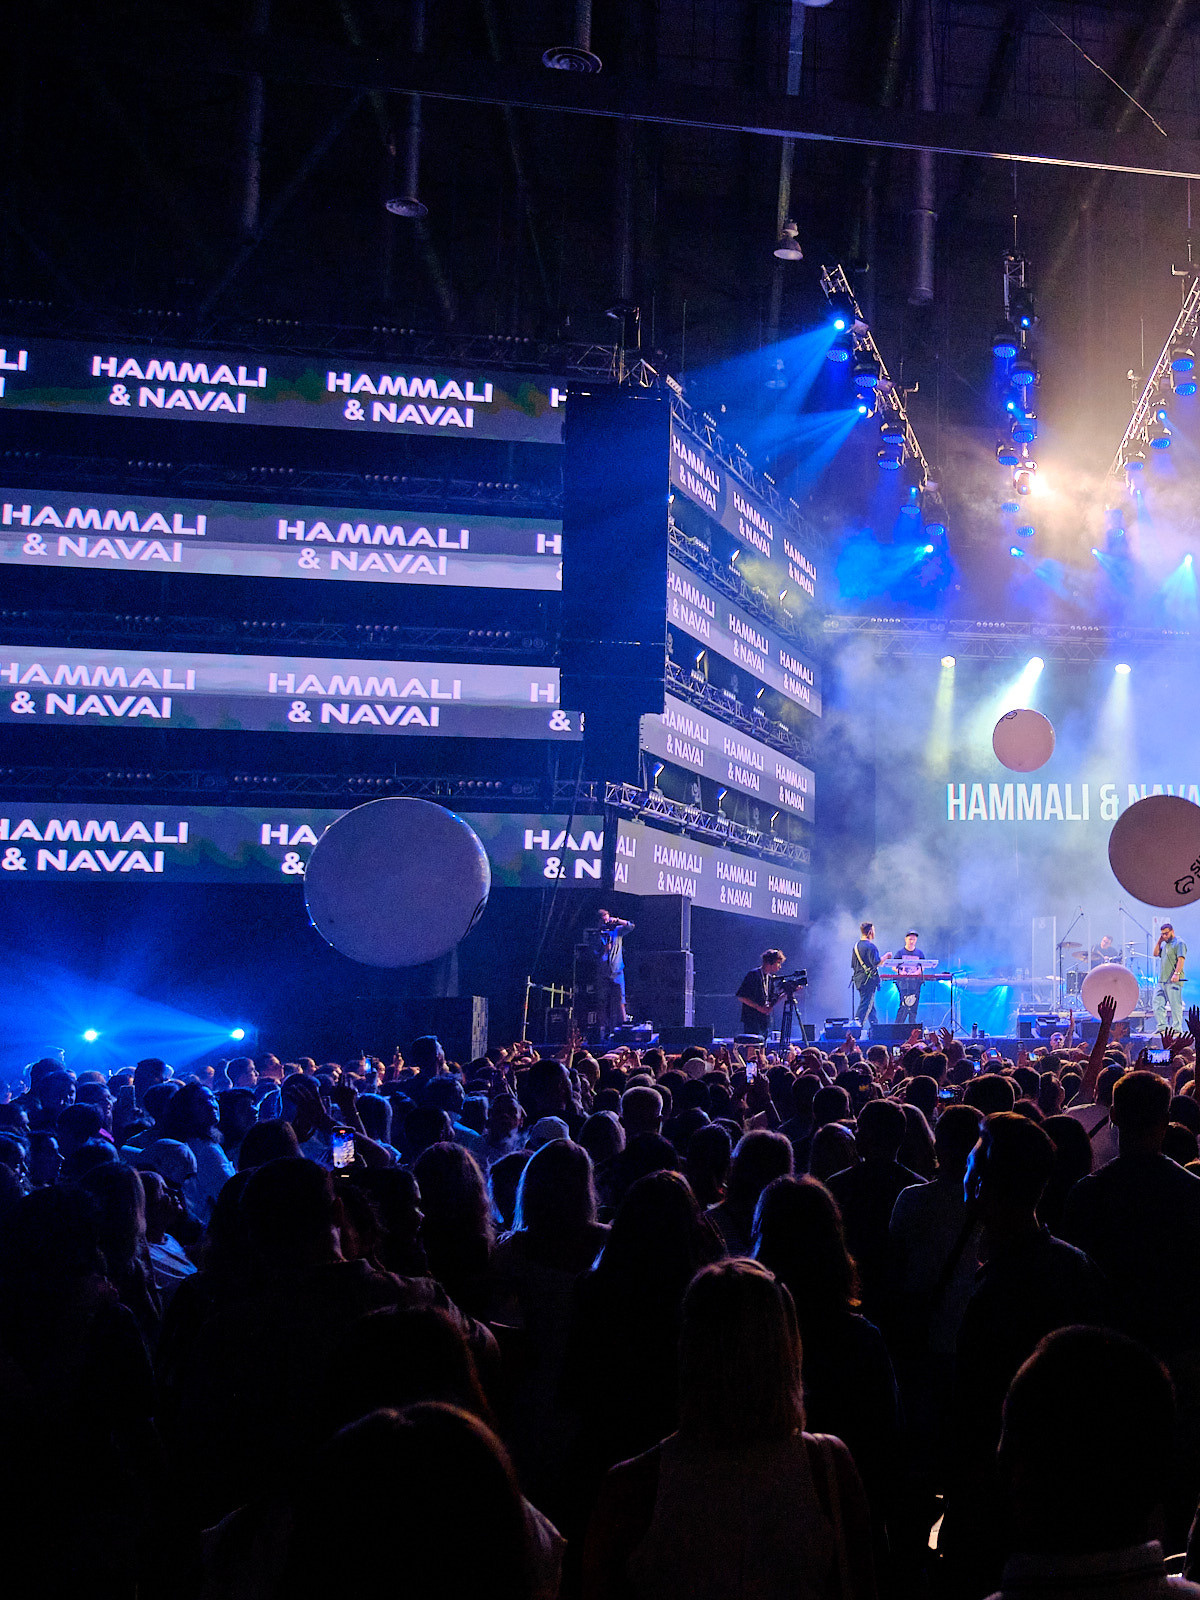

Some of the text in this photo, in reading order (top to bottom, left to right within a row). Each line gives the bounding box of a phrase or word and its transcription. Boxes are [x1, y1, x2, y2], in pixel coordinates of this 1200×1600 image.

[92, 356, 267, 387] HAMMALI
[327, 371, 493, 403] HAMMALI
[108, 384, 246, 414] & NAVAI
[344, 400, 474, 428] & NAVAI
[673, 435, 720, 492] HAMMALI
[679, 466, 716, 511] & NAVAI
[2, 503, 207, 535] HAMMALI
[733, 492, 773, 540] HAMMALI
[22, 533, 182, 563] & NAVAI
[278, 519, 469, 550] HAMMALI
[739, 518, 770, 558] & NAVAI
[298, 548, 447, 576] & NAVAI
[784, 539, 816, 581] HAMMALI
[668, 570, 715, 618] HAMMALI
[789, 563, 814, 597] & NAVAI
[672, 599, 709, 638] & NAVAI
[729, 614, 769, 655] HAMMALI
[734, 640, 764, 674] & NAVAI
[780, 650, 813, 686] HAMMALI
[268, 672, 461, 700] HAMMALI
[784, 674, 810, 704] & NAVAI
[11, 691, 172, 718] & NAVAI
[288, 701, 440, 728] & NAVAI
[662, 709, 709, 745] HAMMALI
[667, 734, 703, 767] & NAVAI
[724, 737, 763, 771] HAMMALI
[727, 763, 760, 791] & NAVAI
[776, 764, 807, 793] HAMMALI
[779, 786, 804, 812] & NAVAI
[947, 783, 1090, 820] HAMMALI
[1100, 783, 1119, 820] &
[1, 847, 164, 873] & NAVAI
[654, 845, 702, 874] HAMMALI
[717, 862, 757, 887] HAMMALI
[658, 873, 696, 897] & NAVAI
[720, 887, 752, 908] & NAVAI
[769, 875, 801, 898] HAMMALI
[771, 898, 798, 917] & NAVAI
